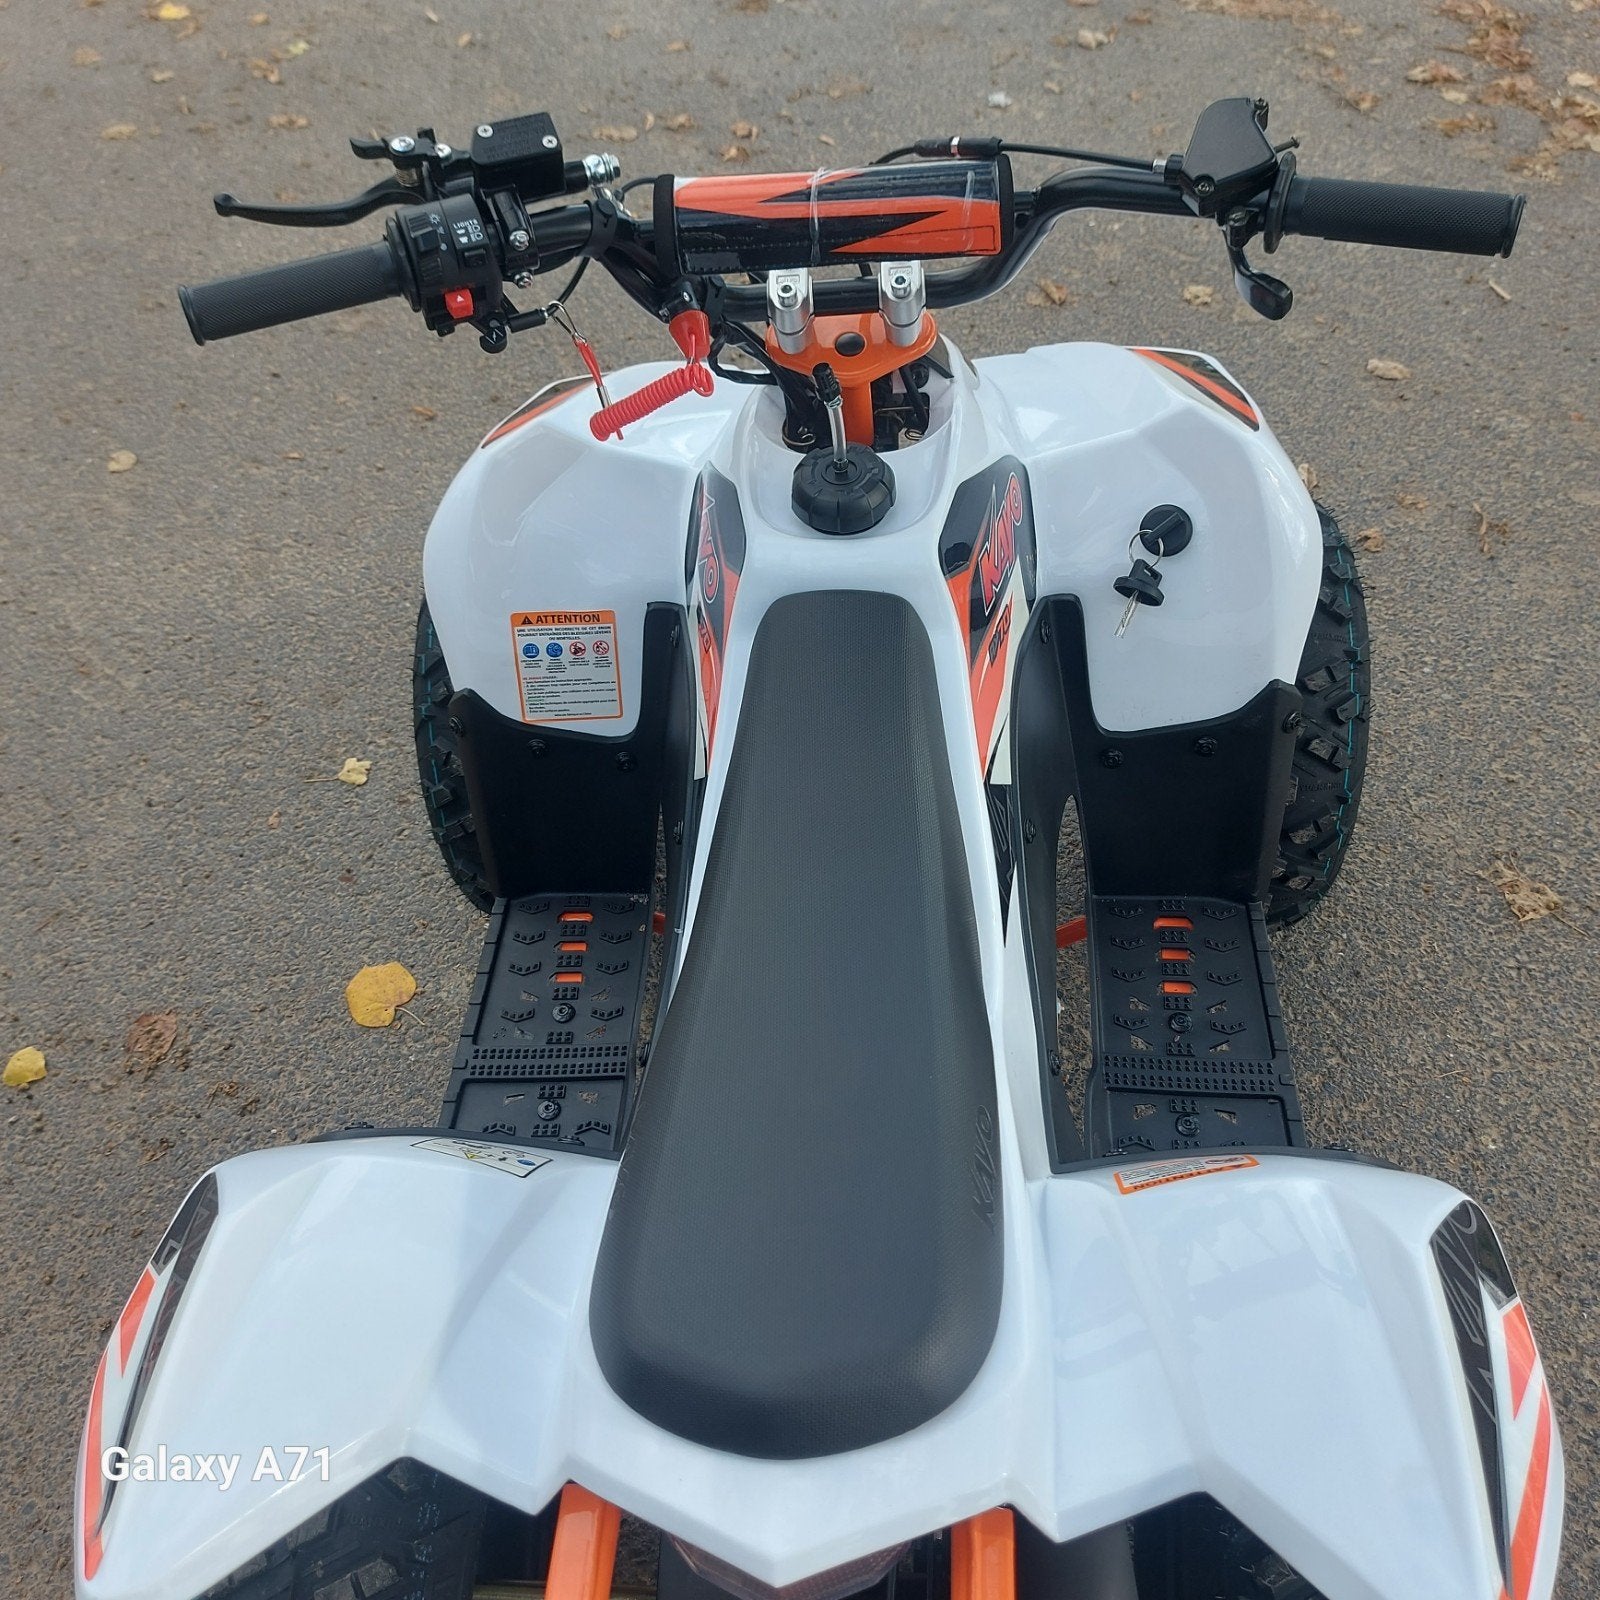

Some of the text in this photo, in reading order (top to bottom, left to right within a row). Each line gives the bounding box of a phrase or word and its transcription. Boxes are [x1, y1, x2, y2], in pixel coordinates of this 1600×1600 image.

[453, 219, 478, 229] LIGHTS
[979, 472, 1023, 617] KAYO
[535, 613, 600, 625] ATTENTION
[1132, 1166, 1224, 1190] ATTENTION
